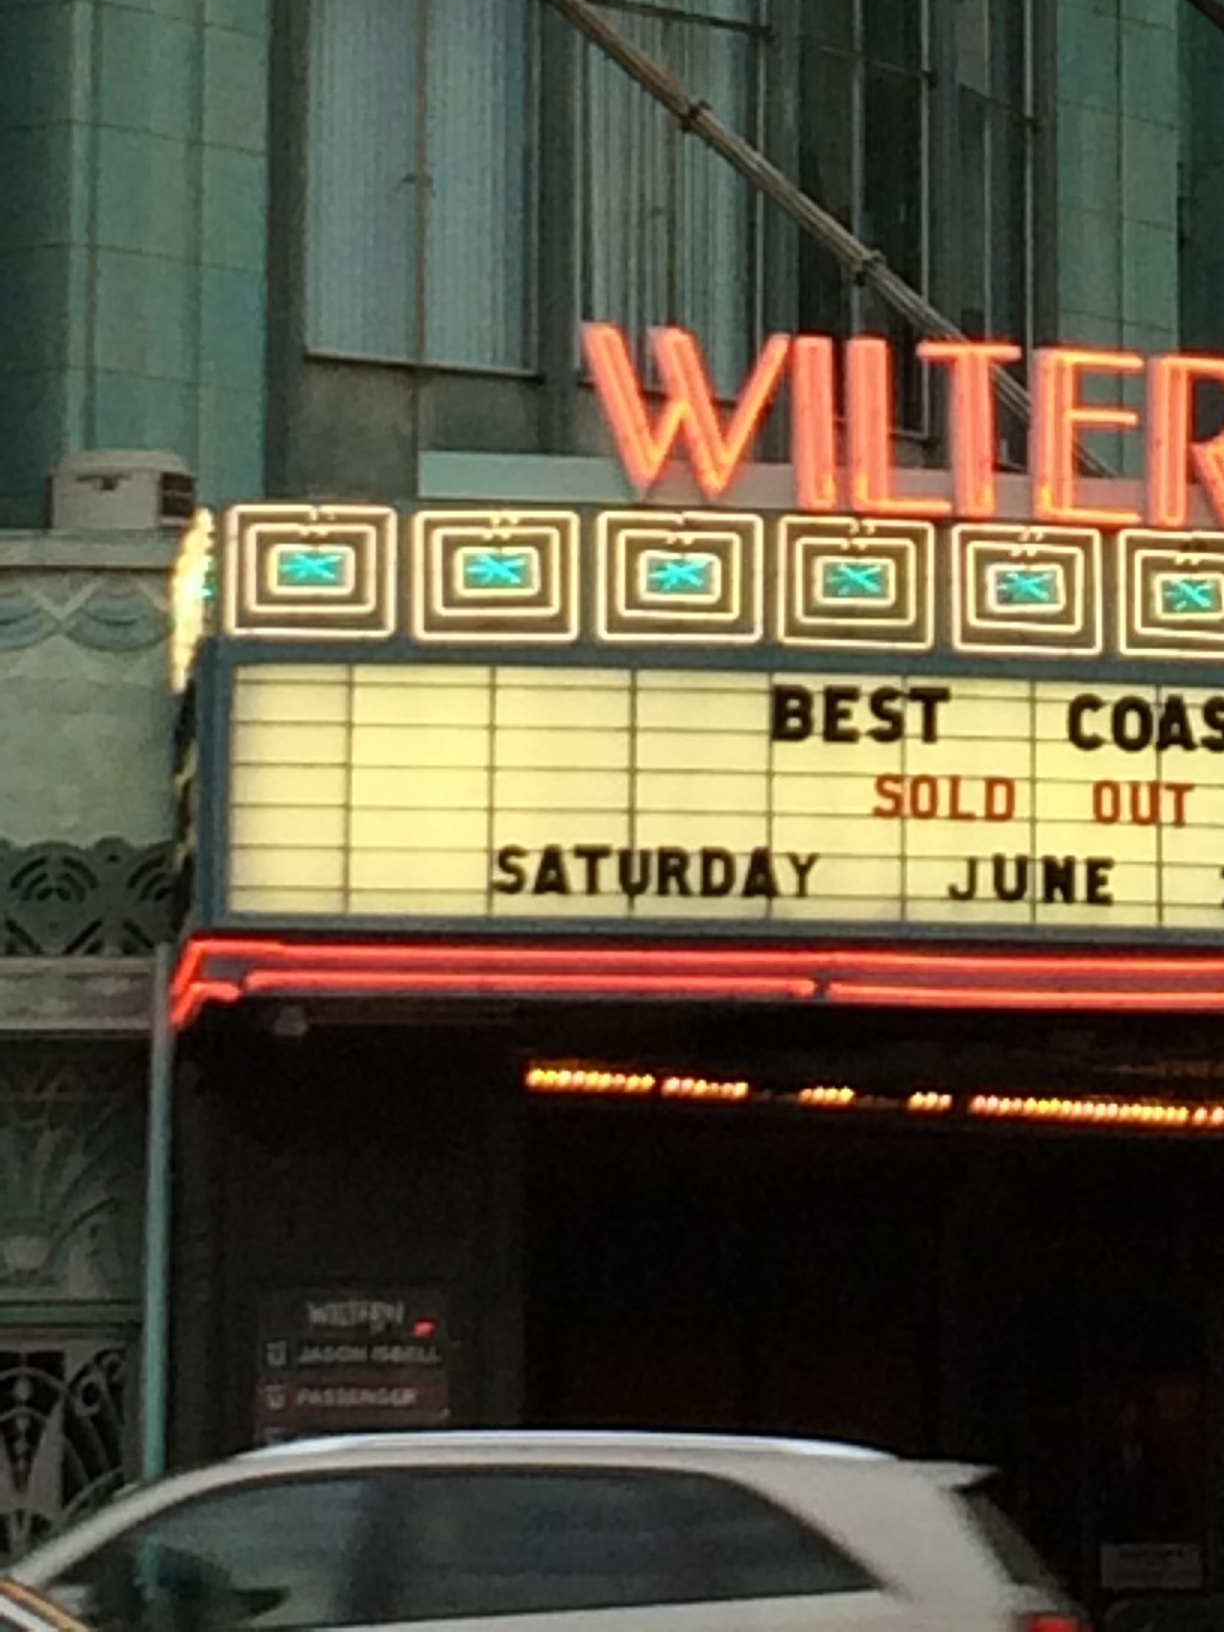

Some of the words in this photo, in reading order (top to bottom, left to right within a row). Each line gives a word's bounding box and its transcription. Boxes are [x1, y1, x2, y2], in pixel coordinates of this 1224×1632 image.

[771, 684, 951, 743] BEST
[873, 774, 1016, 822] SOLD
[1093, 779, 1195, 826] OUT
[492, 844, 821, 898] SATURDAY
[948, 855, 1115, 906] JUNE
